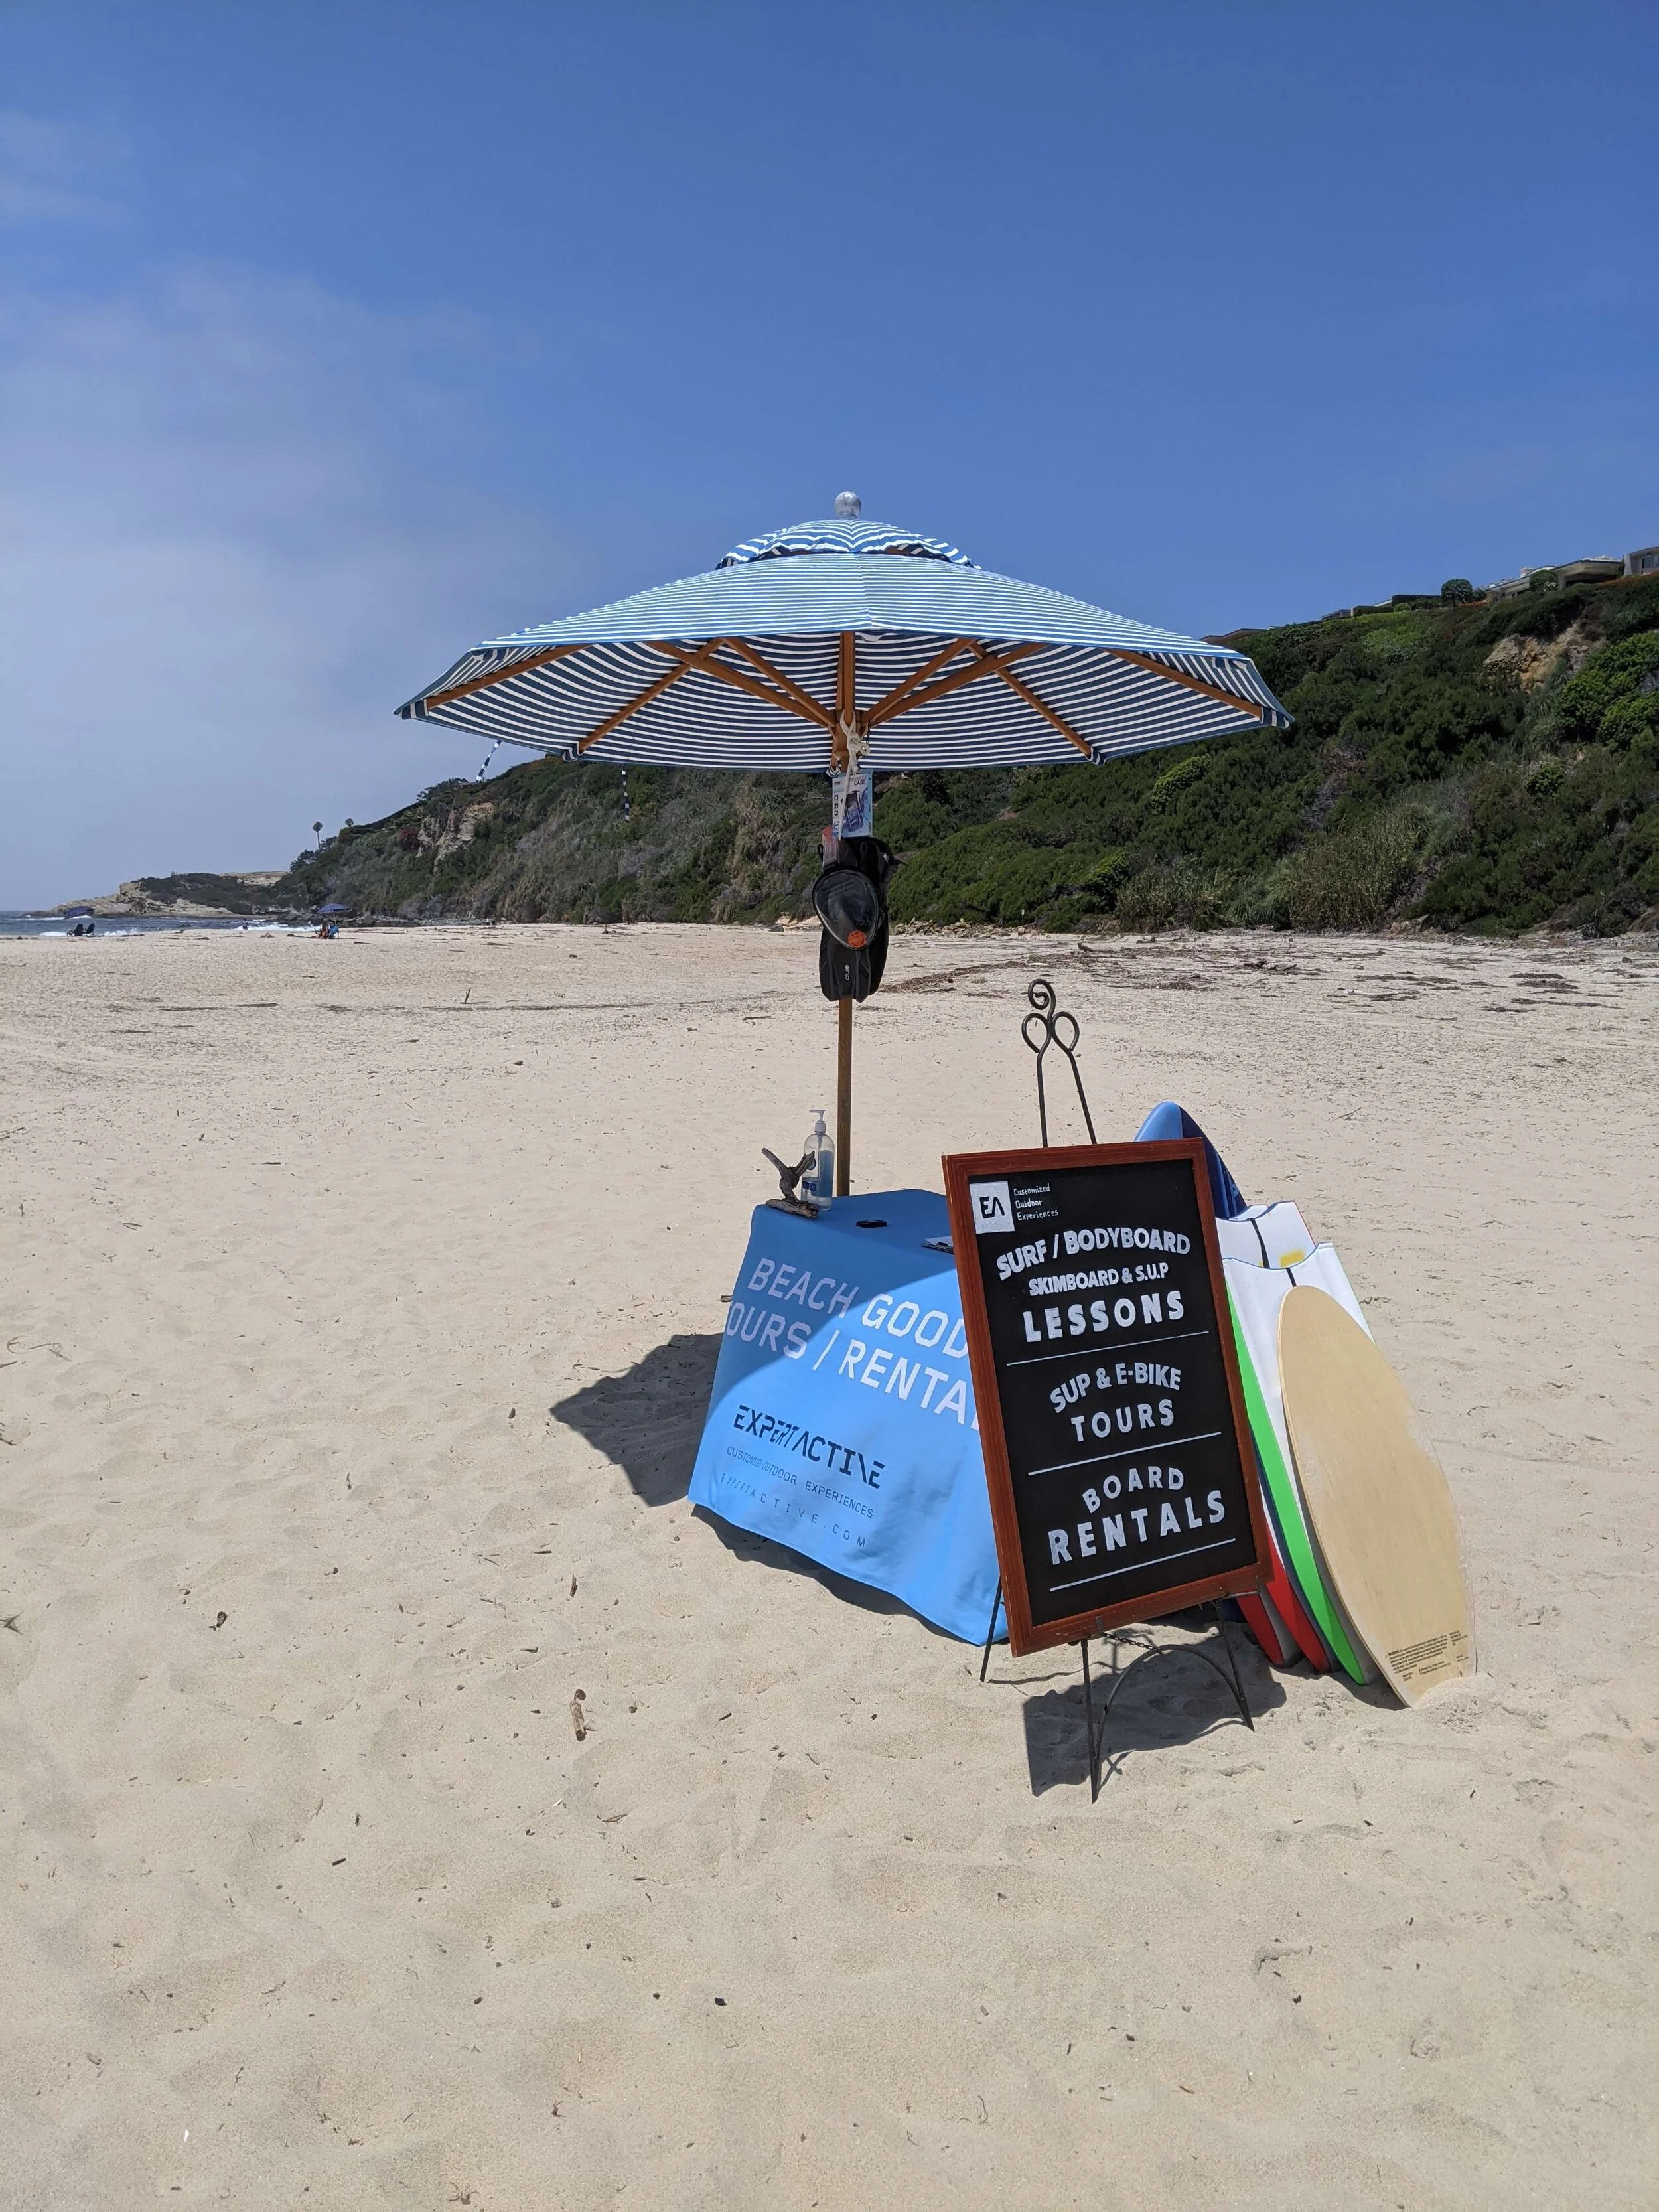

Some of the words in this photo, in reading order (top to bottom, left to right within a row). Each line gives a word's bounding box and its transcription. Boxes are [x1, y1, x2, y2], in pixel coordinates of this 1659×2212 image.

[1013, 1182, 1050, 1196] Customized
[1015, 1197, 1043, 1209] Outdoor
[1017, 1209, 1059, 1221] Experiences
[997, 1239, 1047, 1281] SURF
[1052, 1234, 1060, 1259] /
[1064, 1227, 1190, 1255] BODYBOARD
[747, 1258, 859, 1318] BEACH
[1029, 1268, 1119, 1296] SKIMBOARD
[1121, 1267, 1133, 1284] &
[1135, 1262, 1169, 1282] S.U.P
[727, 1301, 812, 1359] OURS
[812, 1329, 840, 1370] /
[1023, 1290, 1184, 1343] LESSONS
[1050, 1373, 1090, 1413] SUP
[1096, 1368, 1112, 1390] &
[1115, 1362, 1181, 1390] E-BIKE
[1071, 1398, 1175, 1442] TOURS
[805, 1481, 874, 1518] EXPERIENCES
[1082, 1465, 1185, 1514] BOARD
[1048, 1489, 1226, 1565] RENTALS
